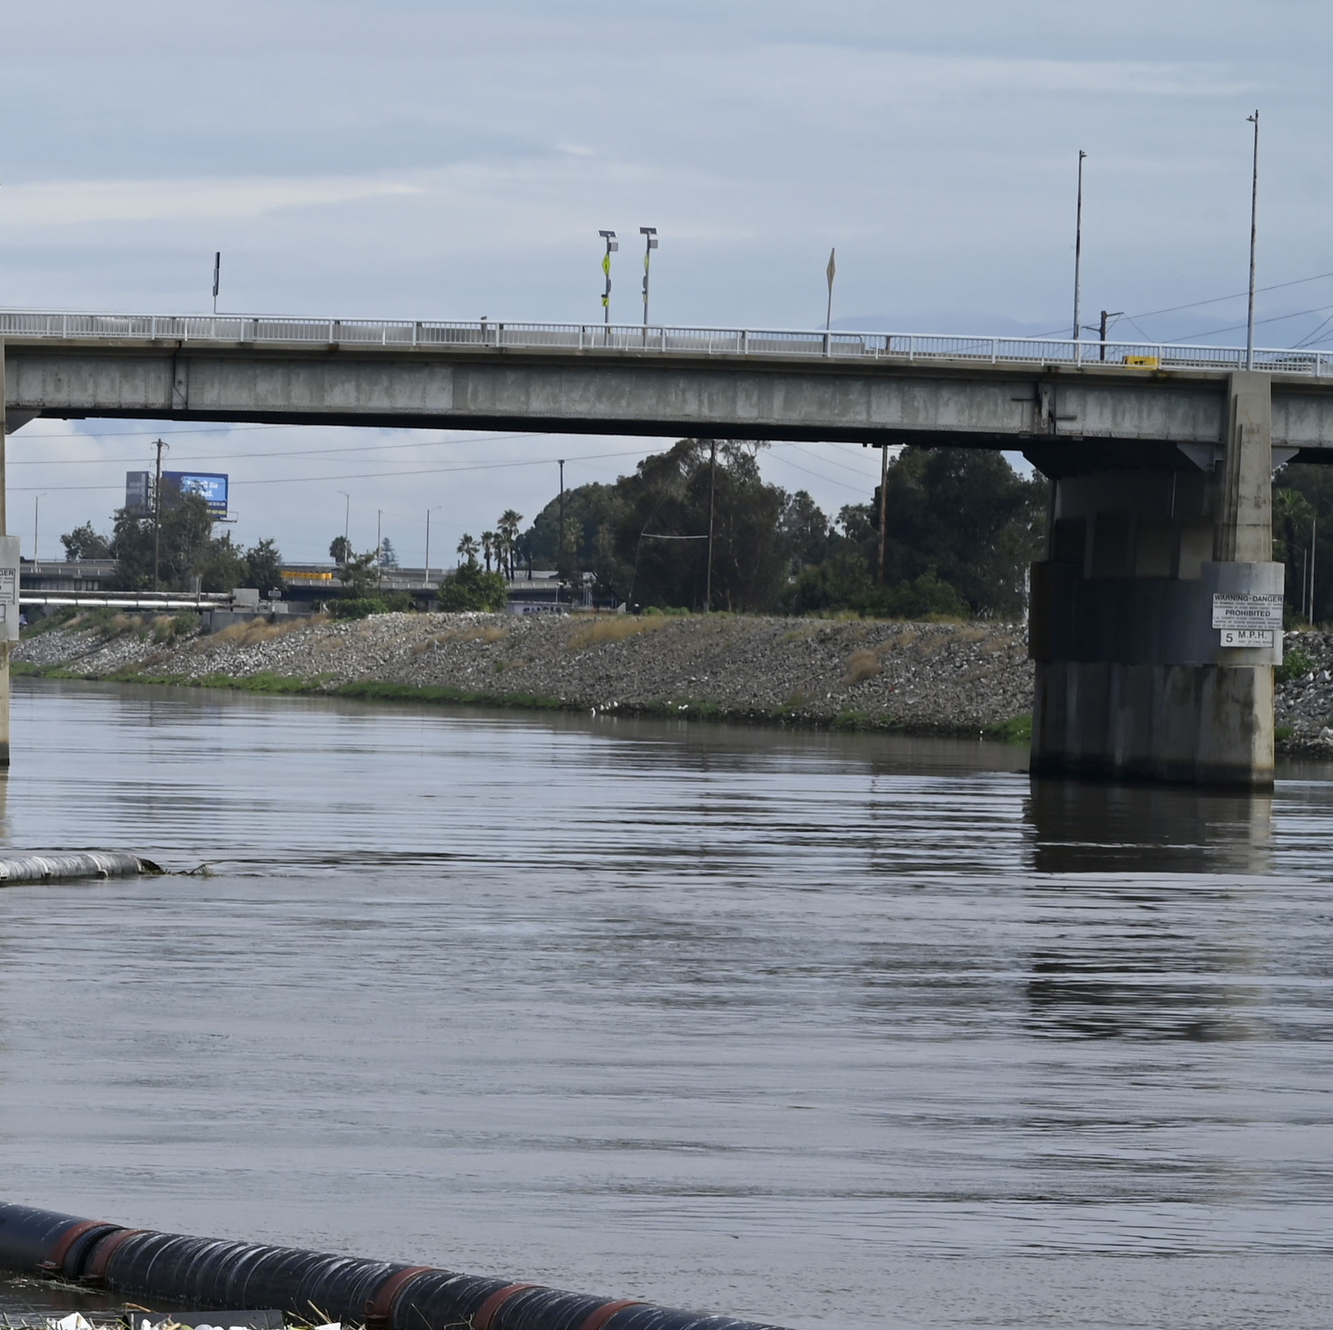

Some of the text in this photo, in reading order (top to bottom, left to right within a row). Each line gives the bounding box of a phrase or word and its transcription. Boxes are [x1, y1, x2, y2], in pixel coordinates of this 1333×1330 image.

[1225, 609, 1271, 617] PROHIBITED
[1225, 633, 1234, 643] 5
[1238, 631, 1267, 639] M.P.H.
